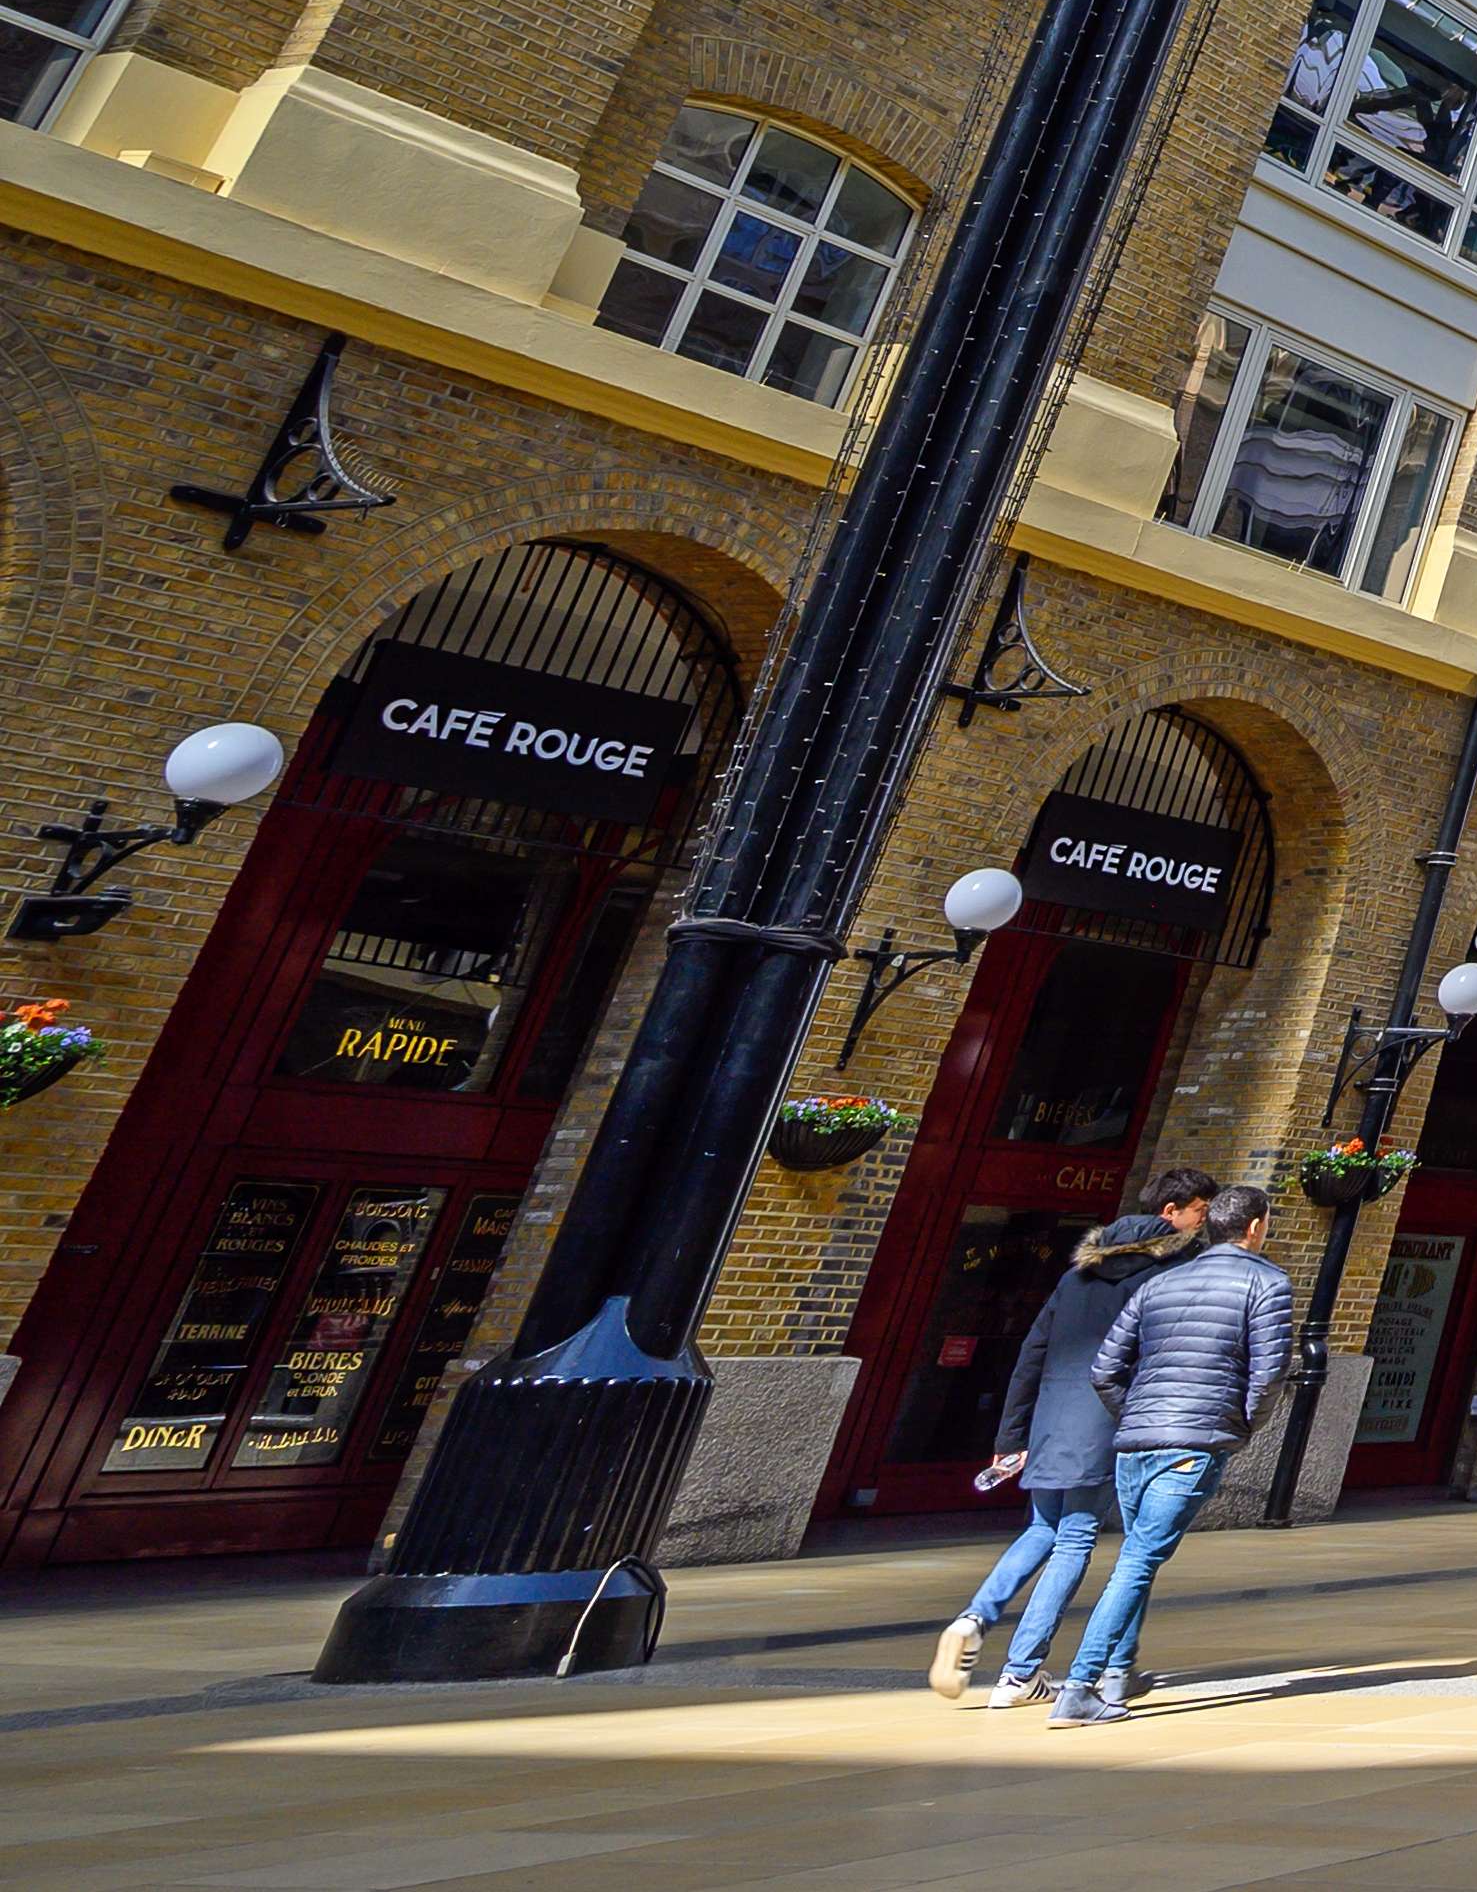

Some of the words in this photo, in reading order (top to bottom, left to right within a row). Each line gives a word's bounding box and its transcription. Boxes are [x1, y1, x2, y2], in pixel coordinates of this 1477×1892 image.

[382, 699, 506, 748] CAFÉ
[504, 721, 655, 778] ROUGE
[1050, 836, 1127, 874] CAFÉ
[1126, 852, 1222, 893] ROUGE
[388, 1016, 426, 1032] MENU
[336, 1028, 459, 1066] RAPIDE
[216, 1238, 285, 1252] ROUGES
[335, 1239, 398, 1252] CHAUDES
[340, 1255, 398, 1266] FROIDES
[178, 1324, 248, 1340] TERRINE
